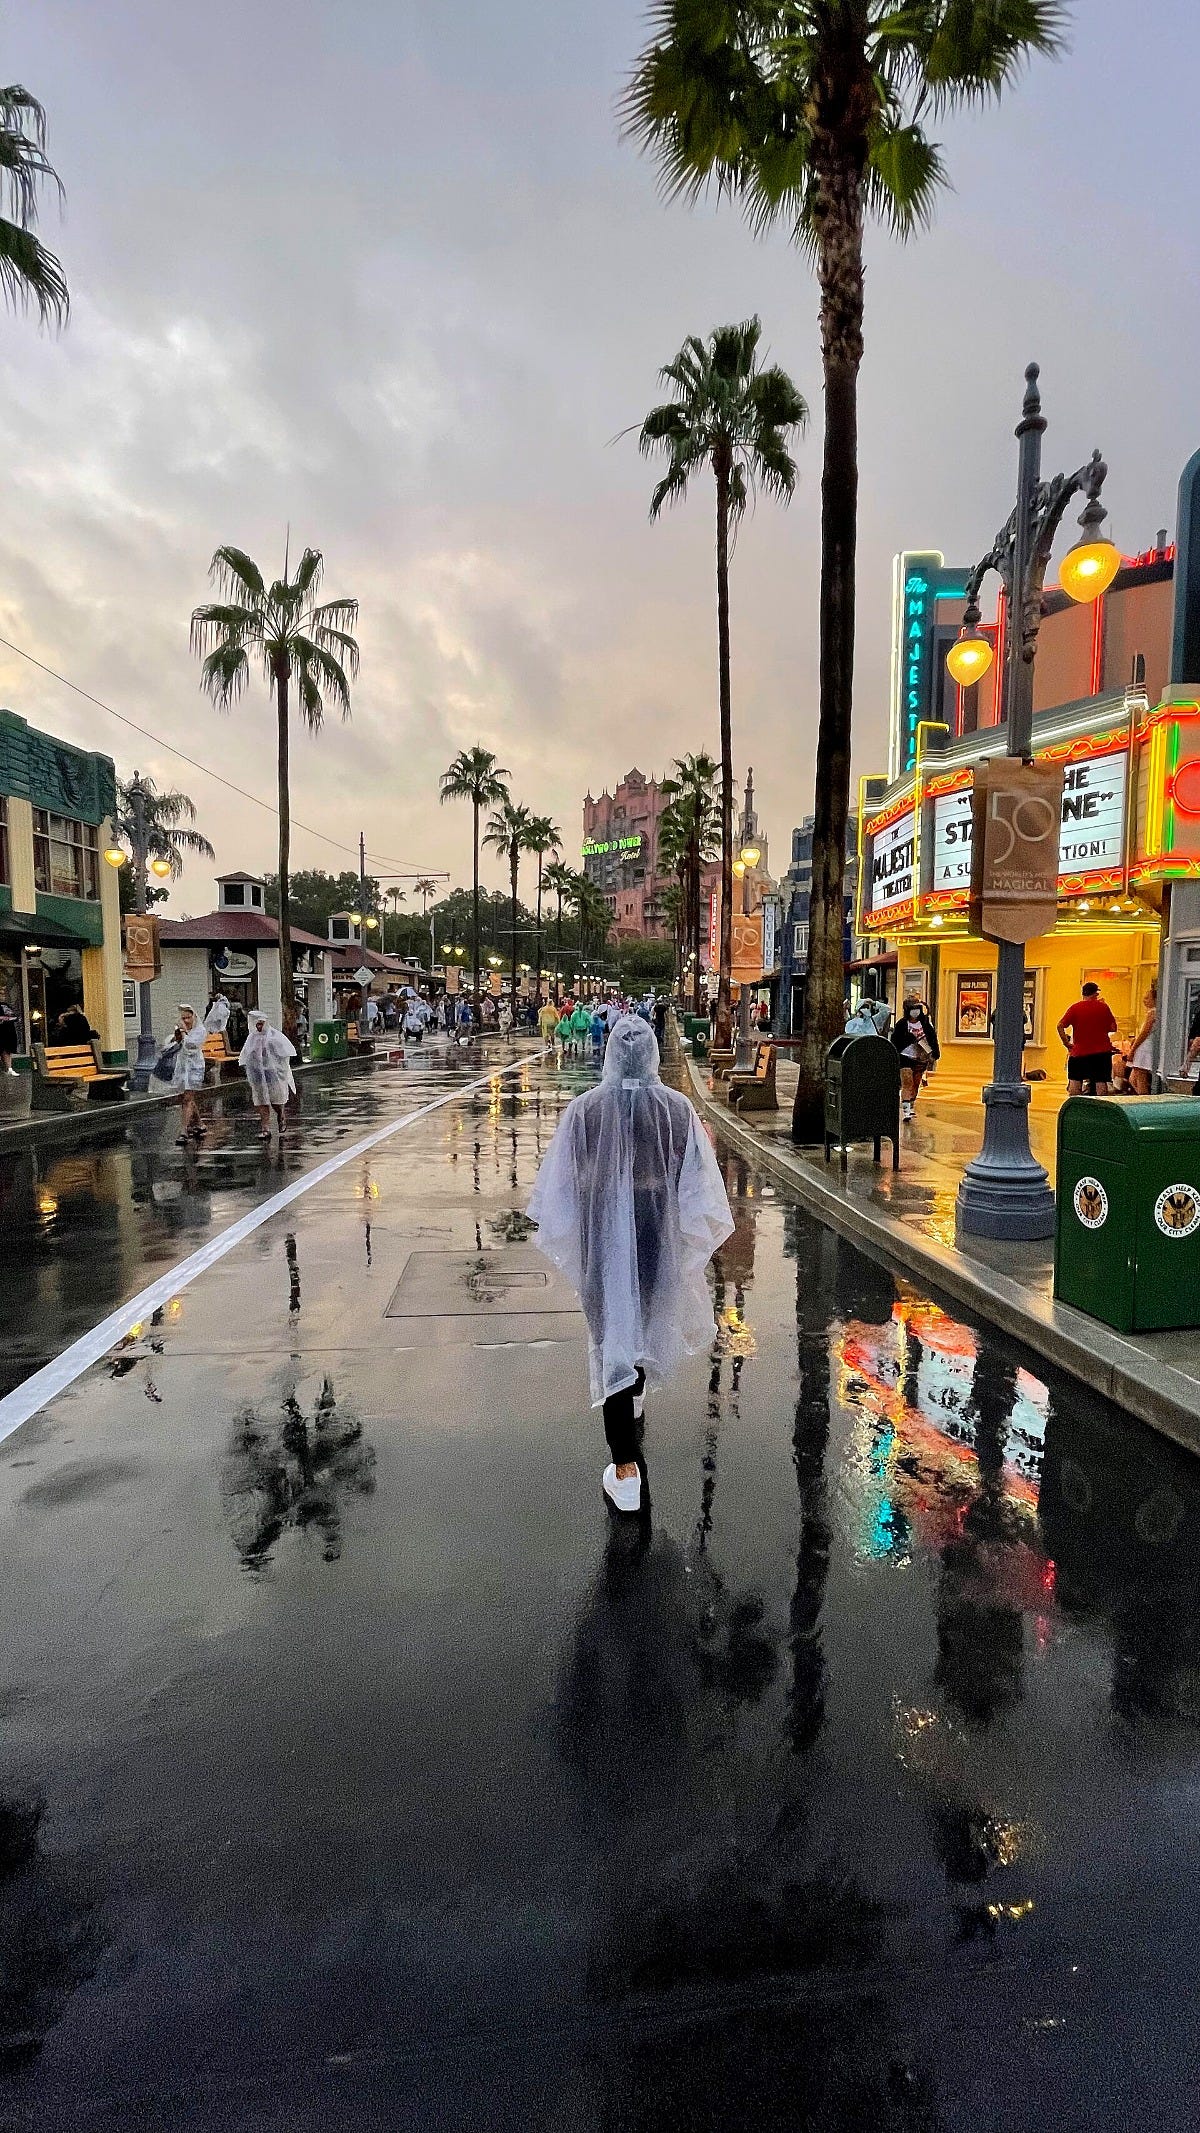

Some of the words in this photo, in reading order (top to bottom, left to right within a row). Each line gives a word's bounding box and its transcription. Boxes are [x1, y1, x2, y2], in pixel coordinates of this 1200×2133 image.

[905, 577, 927, 593] The
[905, 600, 922, 771] MAJESTIC
[1063, 765, 1090, 790] HE
[991, 791, 1056, 864] 50
[943, 868, 951, 879] A
[1062, 841, 1107, 860] TION!
[733, 927, 759, 955] 50
